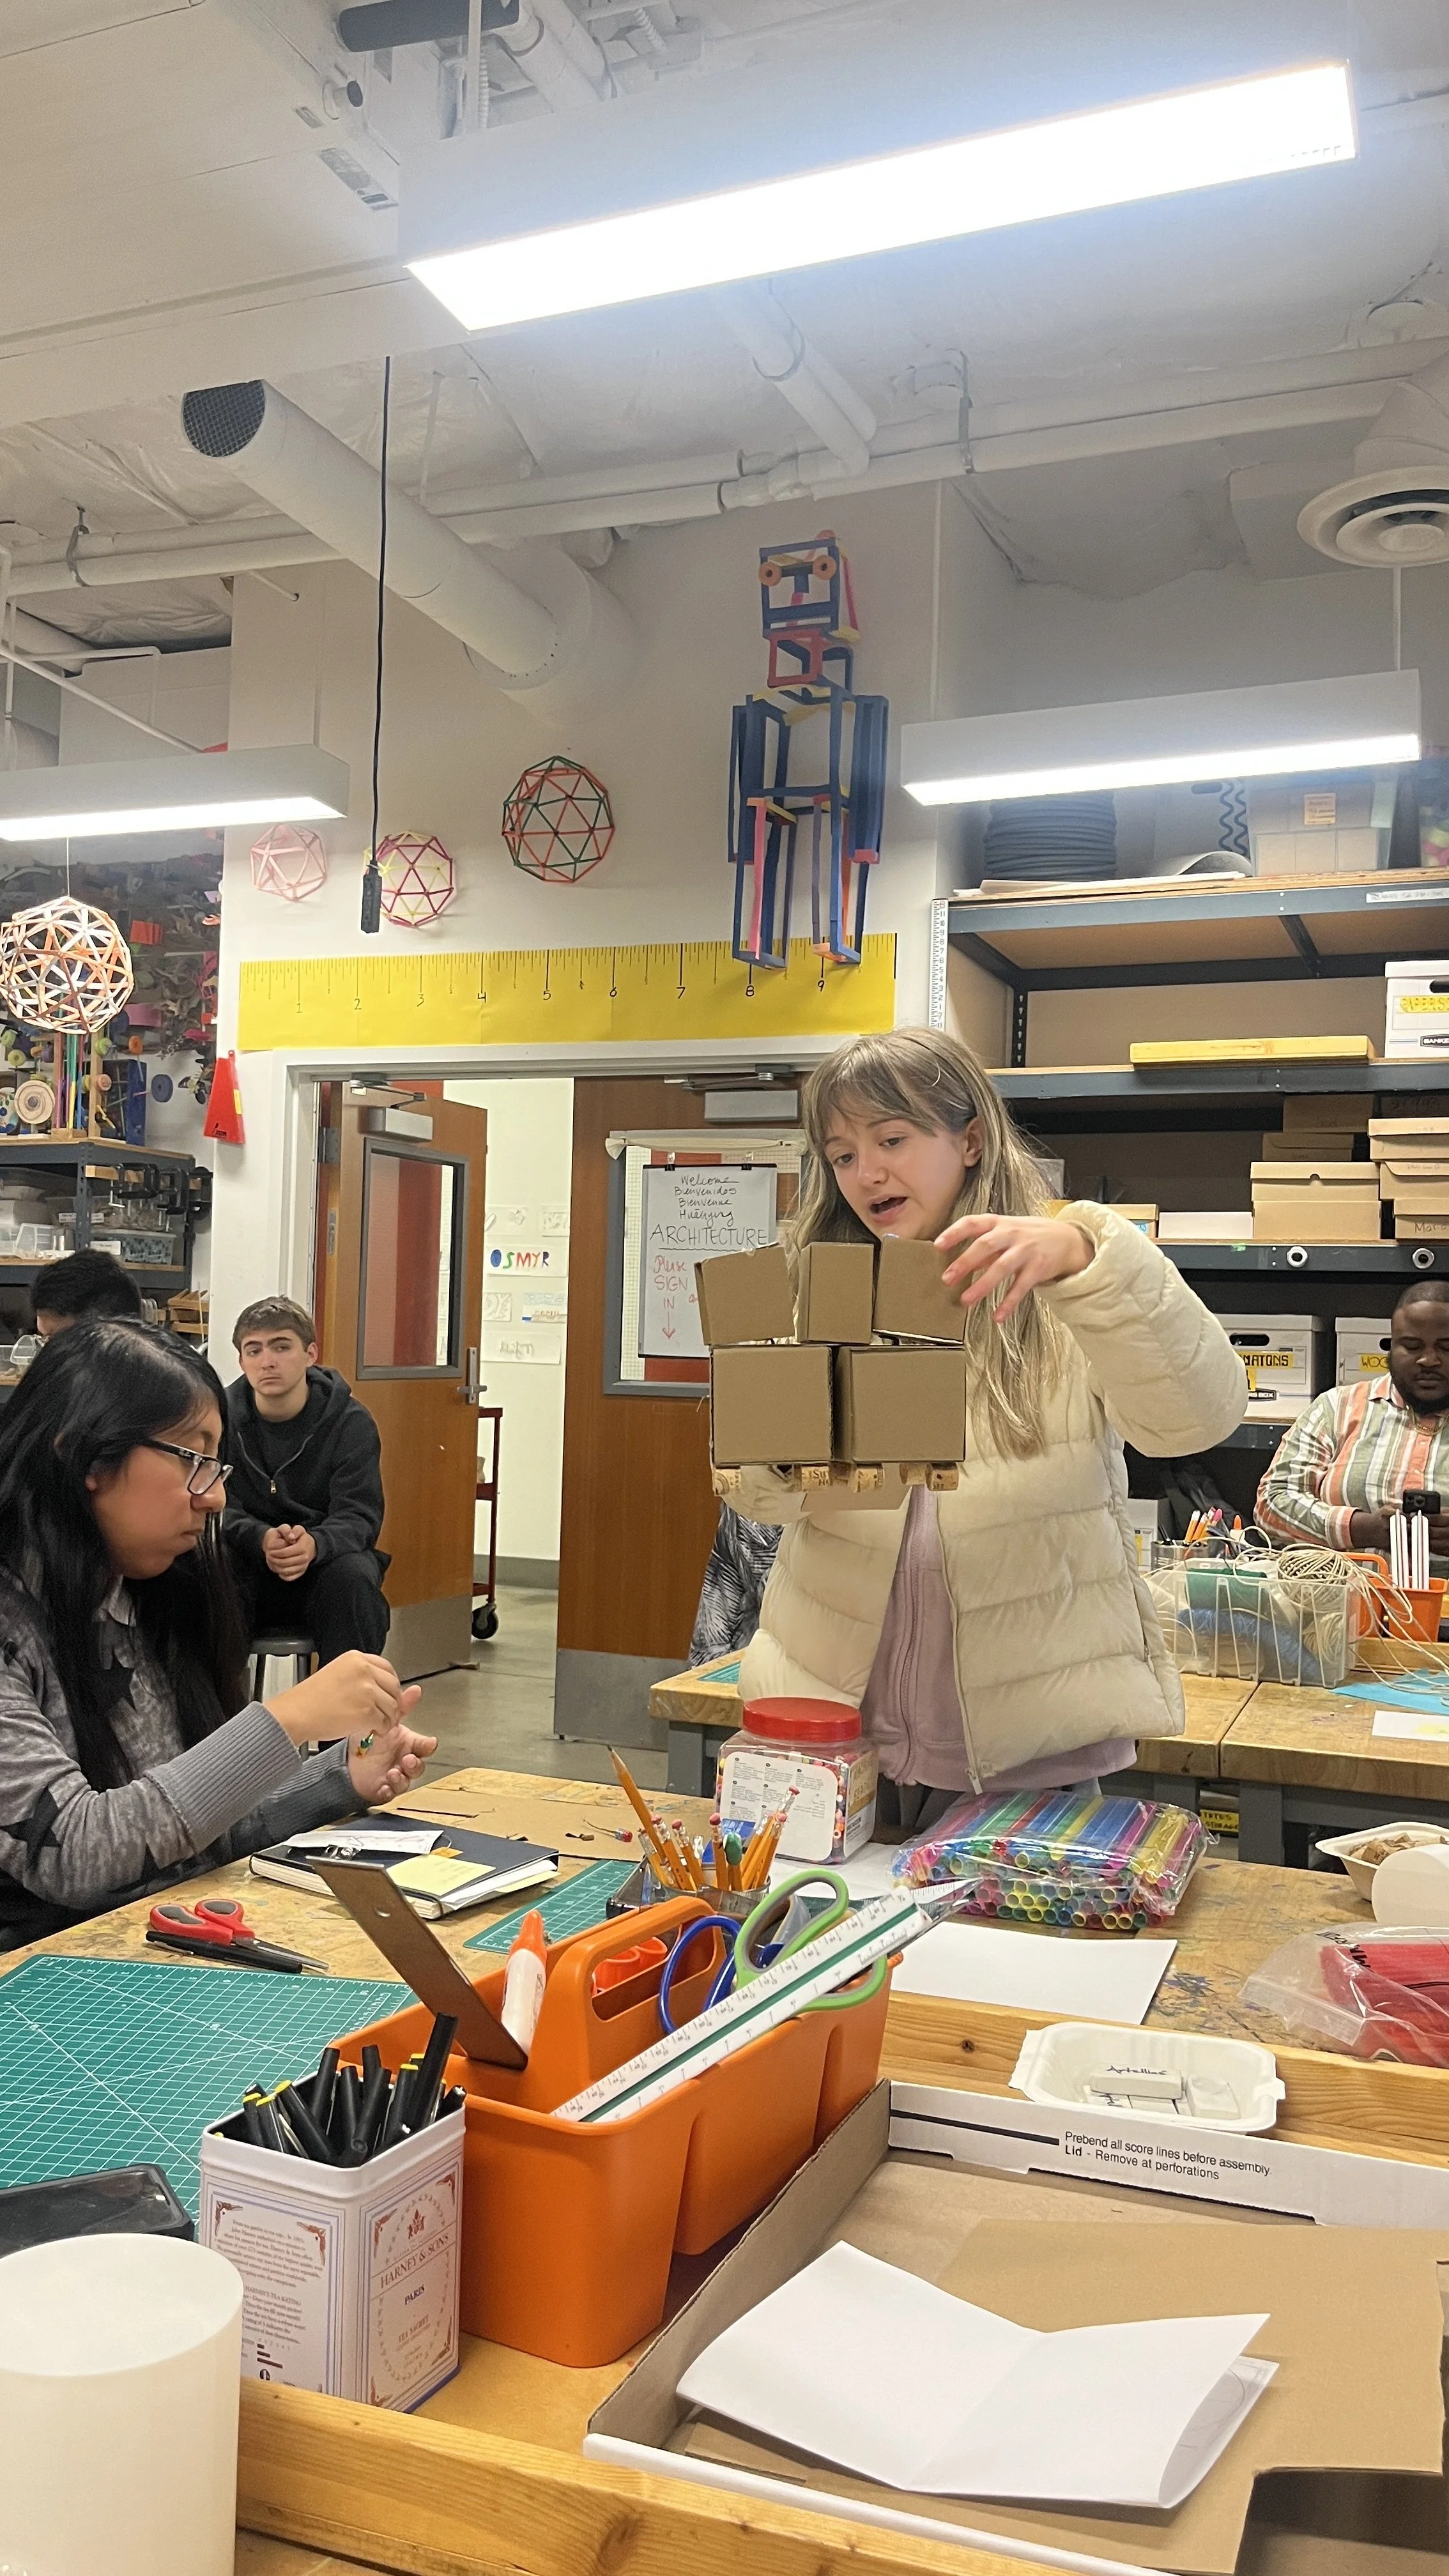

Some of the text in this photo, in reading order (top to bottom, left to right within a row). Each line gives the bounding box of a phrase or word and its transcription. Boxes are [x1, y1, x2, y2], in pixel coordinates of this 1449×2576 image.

[296, 979, 825, 1013] 1 2 3 4 5 6 7 8 9
[681, 1174, 740, 1186] Welcome
[674, 1186, 737, 1197] Bienvenidos
[650, 1223, 767, 1246] ARCHITECTURE
[490, 1249, 550, 1269] OSMYR
[654, 1275, 688, 1291] SIGN
[663, 1296, 675, 1308] IN
[1243, 1354, 1289, 1367] MATONS
[1065, 2131, 1272, 2177] Prebend all score lines before assembly.
[1065, 2144, 1083, 2157] Lid
[1095, 2150, 1138, 2166] Remove
[1142, 2158, 1152, 2169] at
[1155, 2160, 1220, 2180] perforations
[381, 2255, 417, 2289] HARNEY
[418, 2250, 427, 2263] &
[427, 2234, 449, 2257] SONS
[404, 2284, 425, 2306] PARIS
